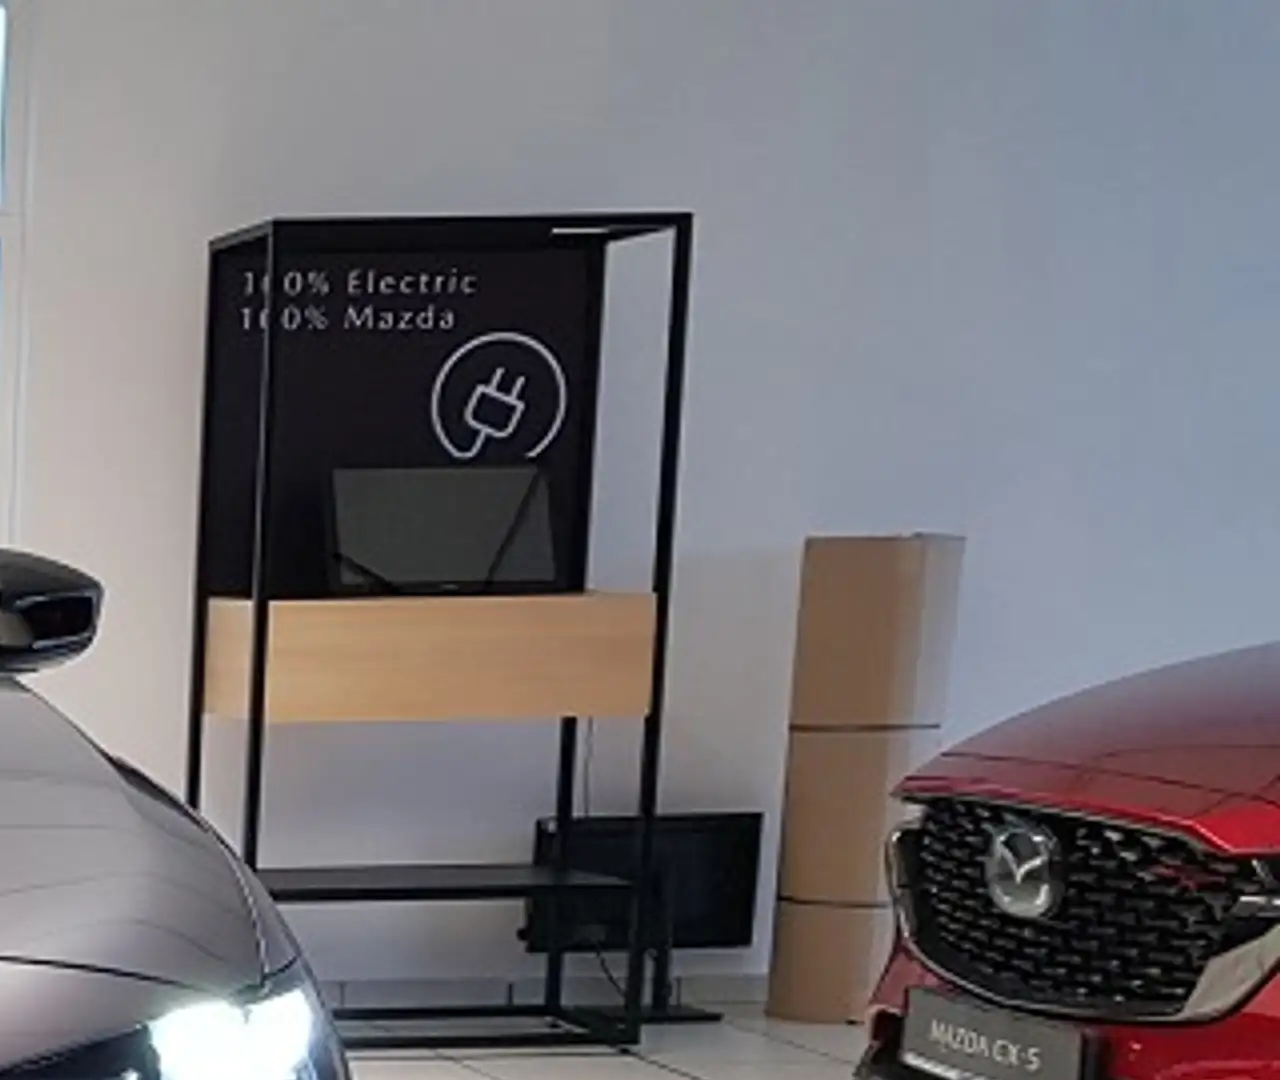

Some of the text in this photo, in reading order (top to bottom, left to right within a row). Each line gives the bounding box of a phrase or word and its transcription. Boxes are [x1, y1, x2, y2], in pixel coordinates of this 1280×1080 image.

[346, 267, 478, 296] Electric
[343, 303, 455, 331] Mazda
[930, 1019, 989, 1058] MAZDA
[992, 1039, 1042, 1072] CX-5
